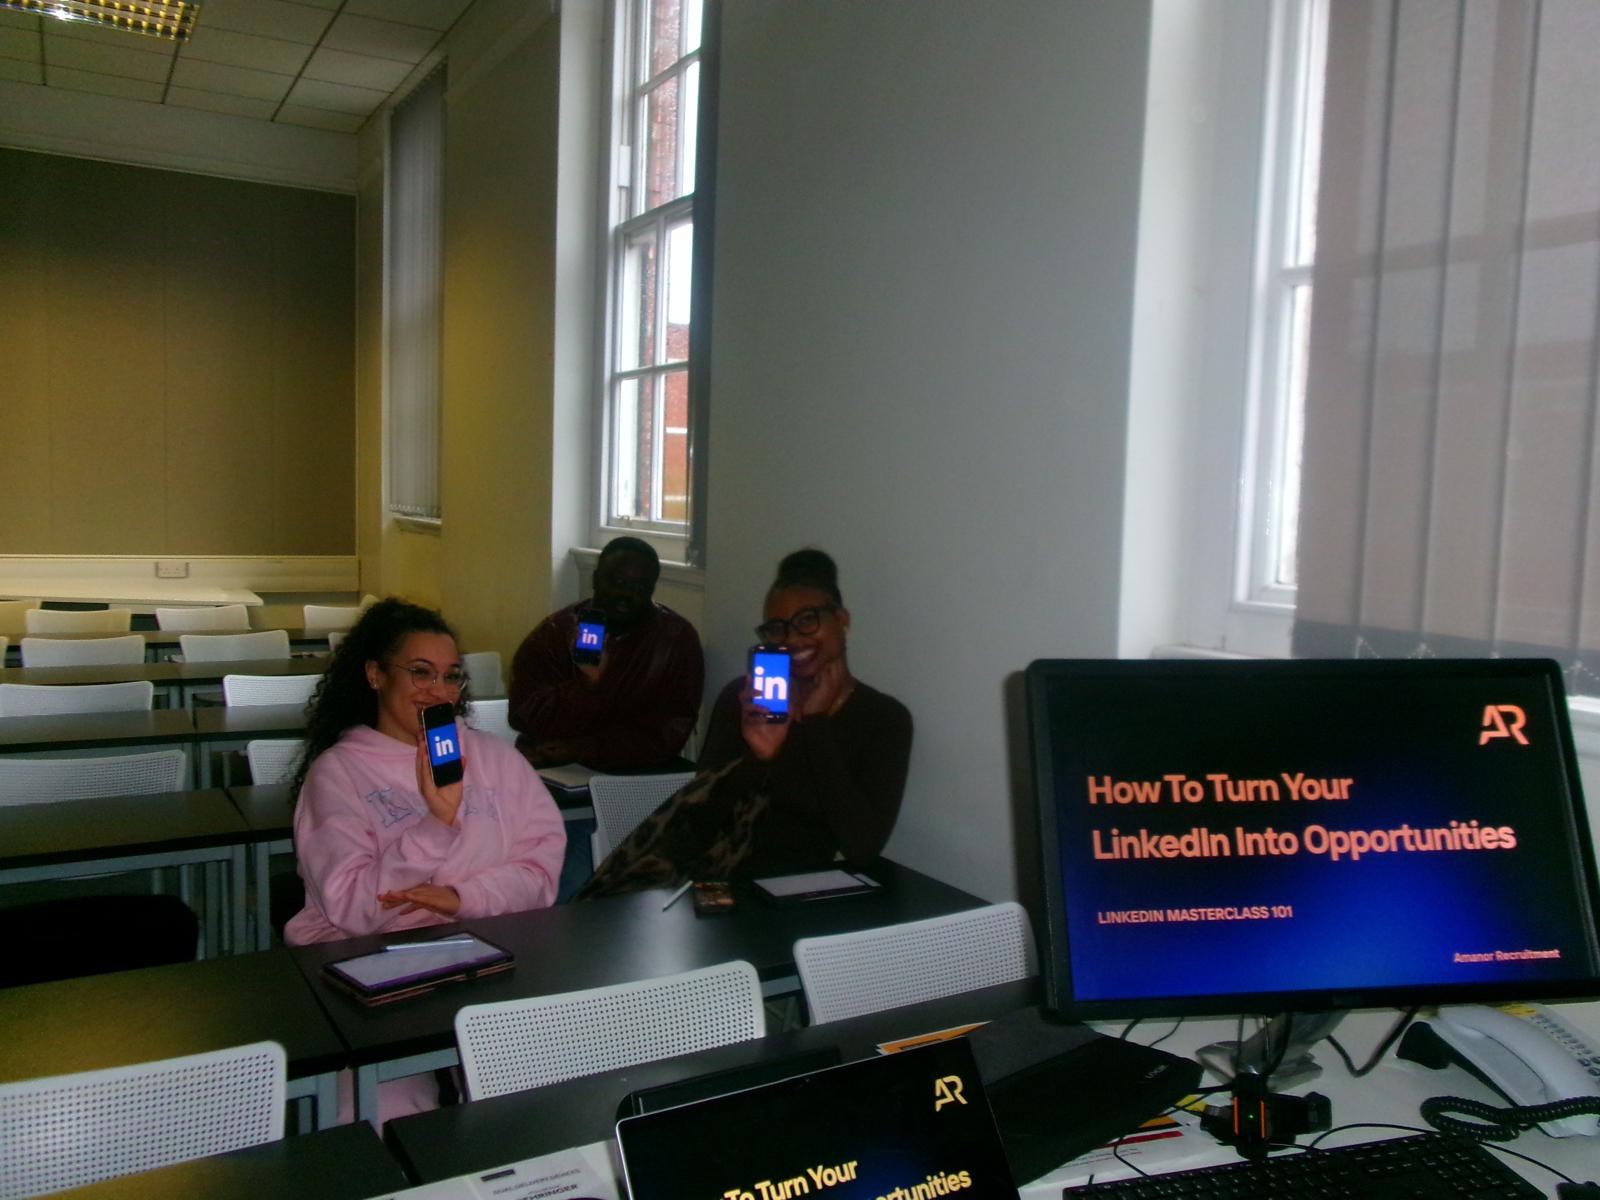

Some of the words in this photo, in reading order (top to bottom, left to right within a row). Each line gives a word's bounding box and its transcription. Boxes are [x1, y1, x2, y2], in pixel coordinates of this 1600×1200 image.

[581, 629, 598, 645] in
[753, 666, 788, 700] in
[1478, 704, 1530, 746] AR
[434, 736, 454, 757] in
[1087, 775, 1161, 804] How
[1163, 774, 1204, 803] To
[1206, 773, 1280, 802] Turn
[1281, 772, 1354, 801] Your
[1092, 827, 1231, 860] LinkedIn
[1235, 826, 1299, 856] Into
[1303, 819, 1518, 861] Opportunities
[1098, 909, 1165, 924] LINKEDIN
[1167, 906, 1269, 922] MASTERCLASS
[1270, 905, 1293, 918] 101
[1495, 949, 1560, 961] Recruitment
[935, 1075, 968, 1112] AR
[754, 1177, 809, 1200] Turn
[806, 1160, 858, 1190] Your
